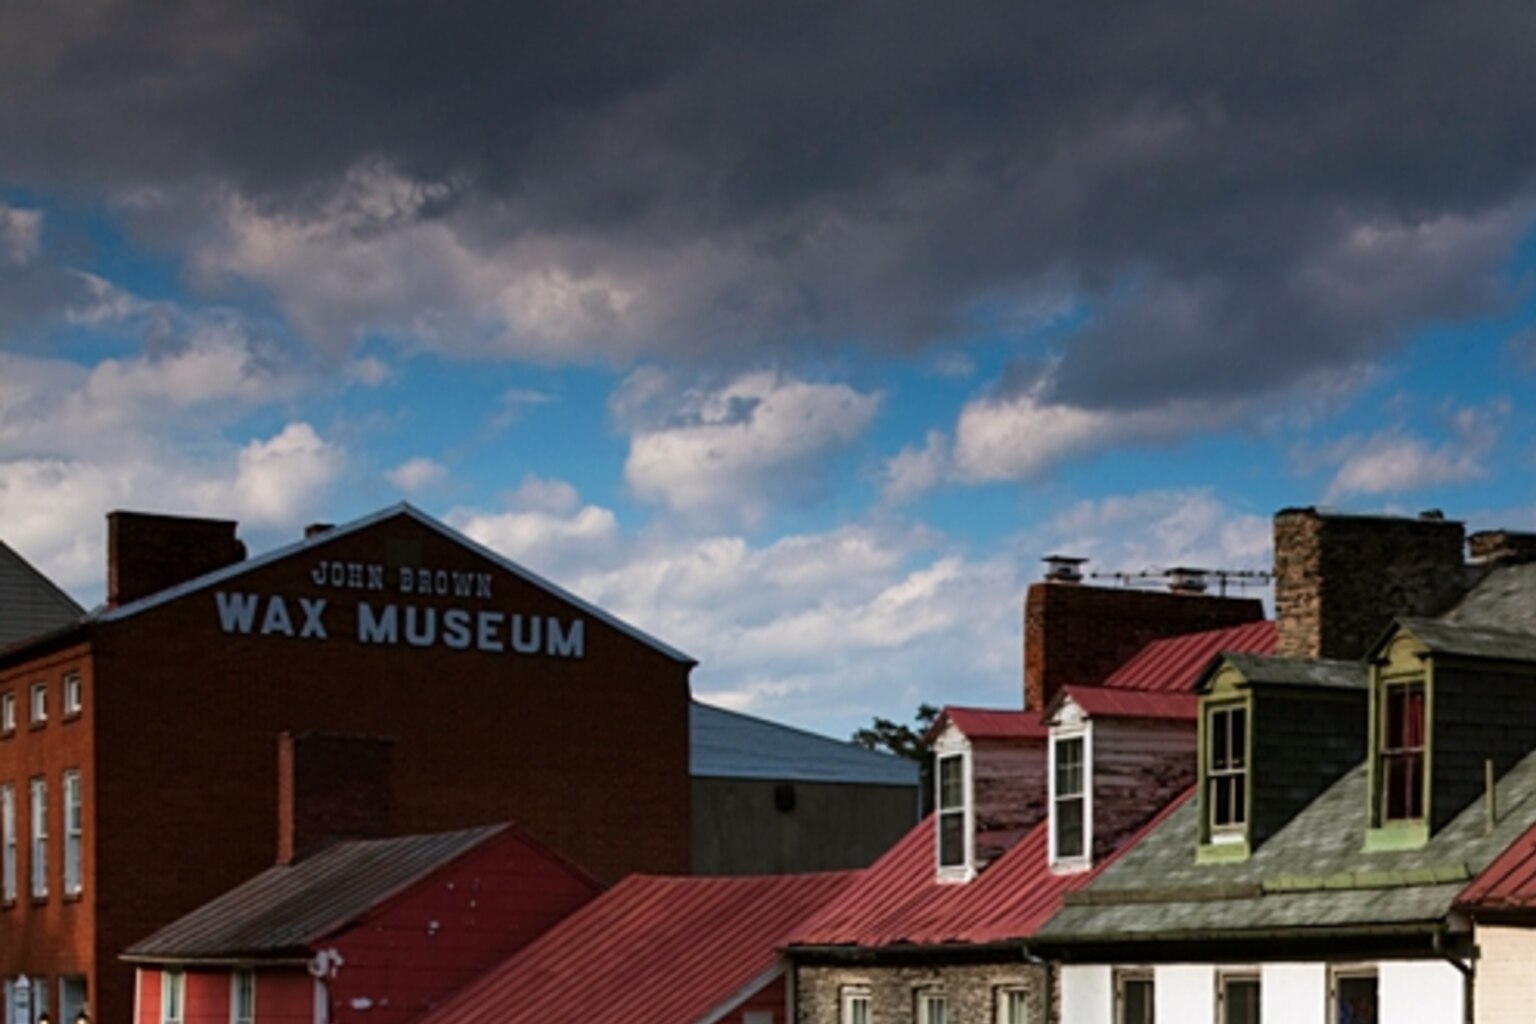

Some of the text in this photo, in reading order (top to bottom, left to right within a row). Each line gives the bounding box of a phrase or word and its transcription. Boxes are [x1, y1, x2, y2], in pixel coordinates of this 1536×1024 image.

[311, 561, 493, 598] JOHN BROWN
[215, 592, 586, 658] WAX MUSEUM
